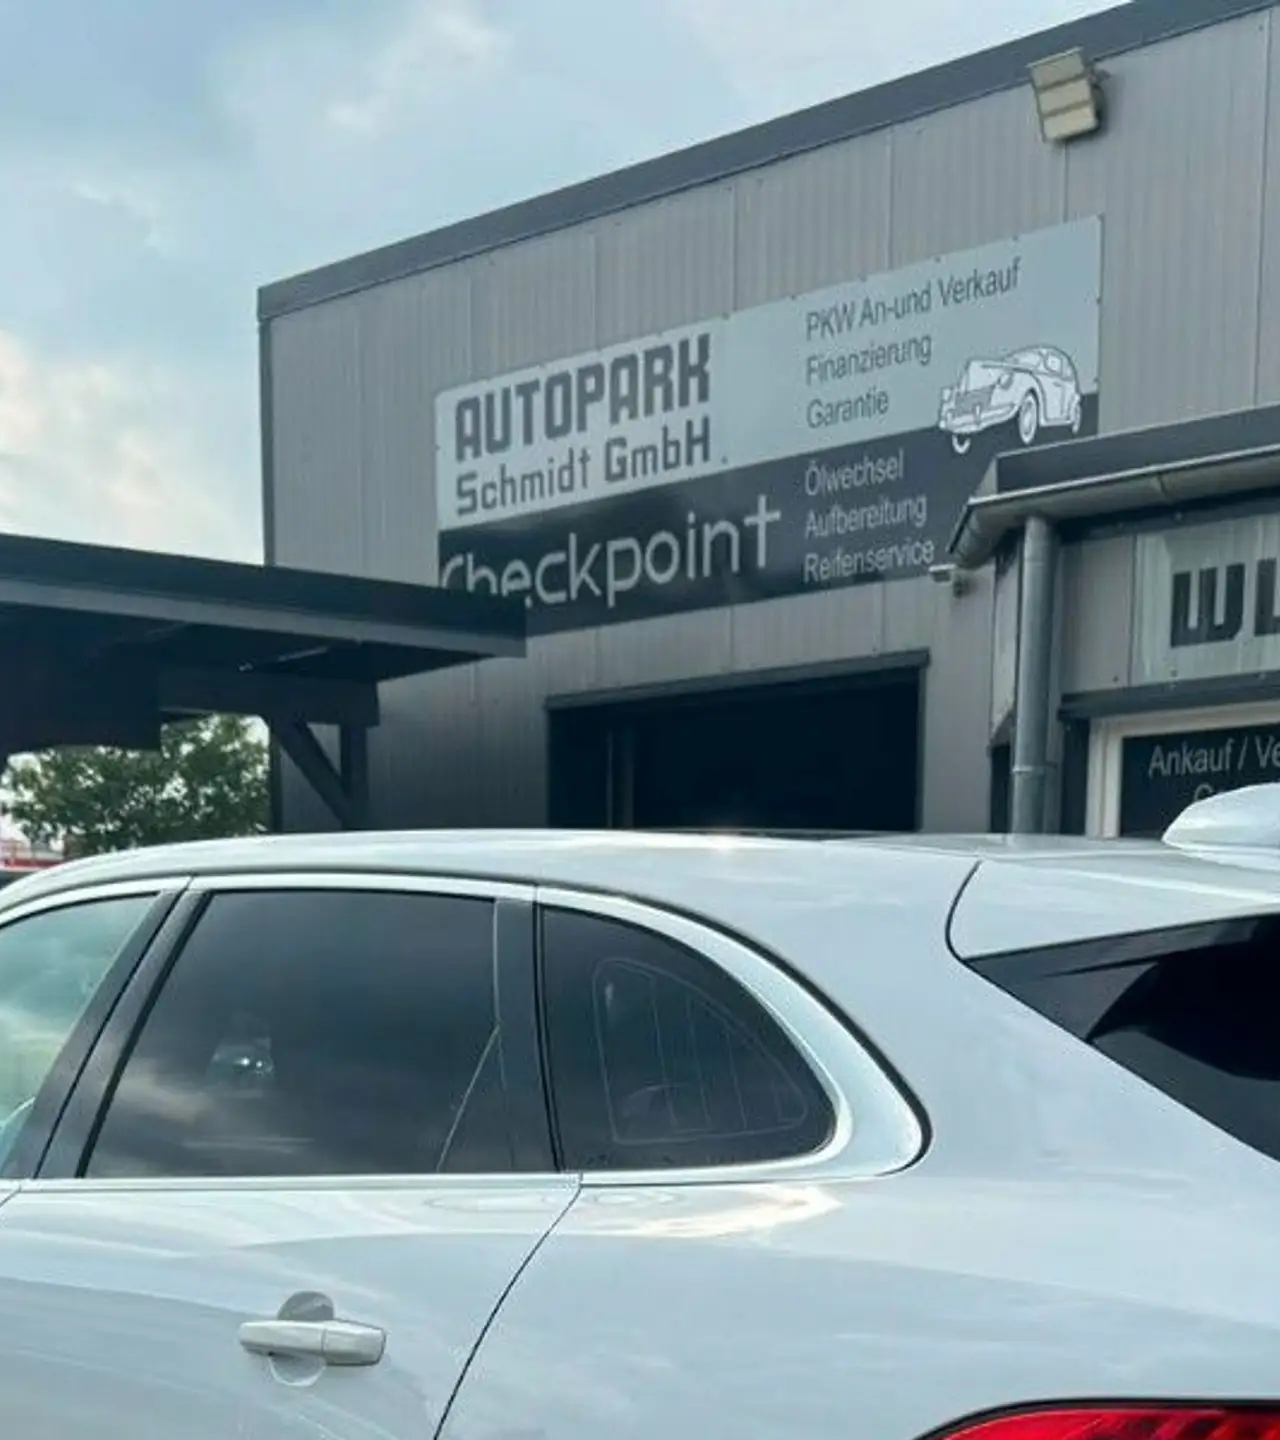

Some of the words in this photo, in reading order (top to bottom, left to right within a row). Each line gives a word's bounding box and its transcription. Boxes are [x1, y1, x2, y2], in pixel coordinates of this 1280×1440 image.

[806, 301, 855, 340] PKW
[937, 256, 1021, 306] Verkauf
[806, 335, 932, 386] Finanzierung
[455, 332, 711, 463] AUTOPARK
[806, 384, 889, 431] Garantie
[456, 450, 589, 517] Schmidt
[604, 417, 710, 482] GmbH
[805, 449, 904, 496] Ölwechsel
[805, 496, 927, 539] Aufbereitung
[804, 538, 935, 583] Reifenservice
[1149, 738, 1235, 778] Ankauf
